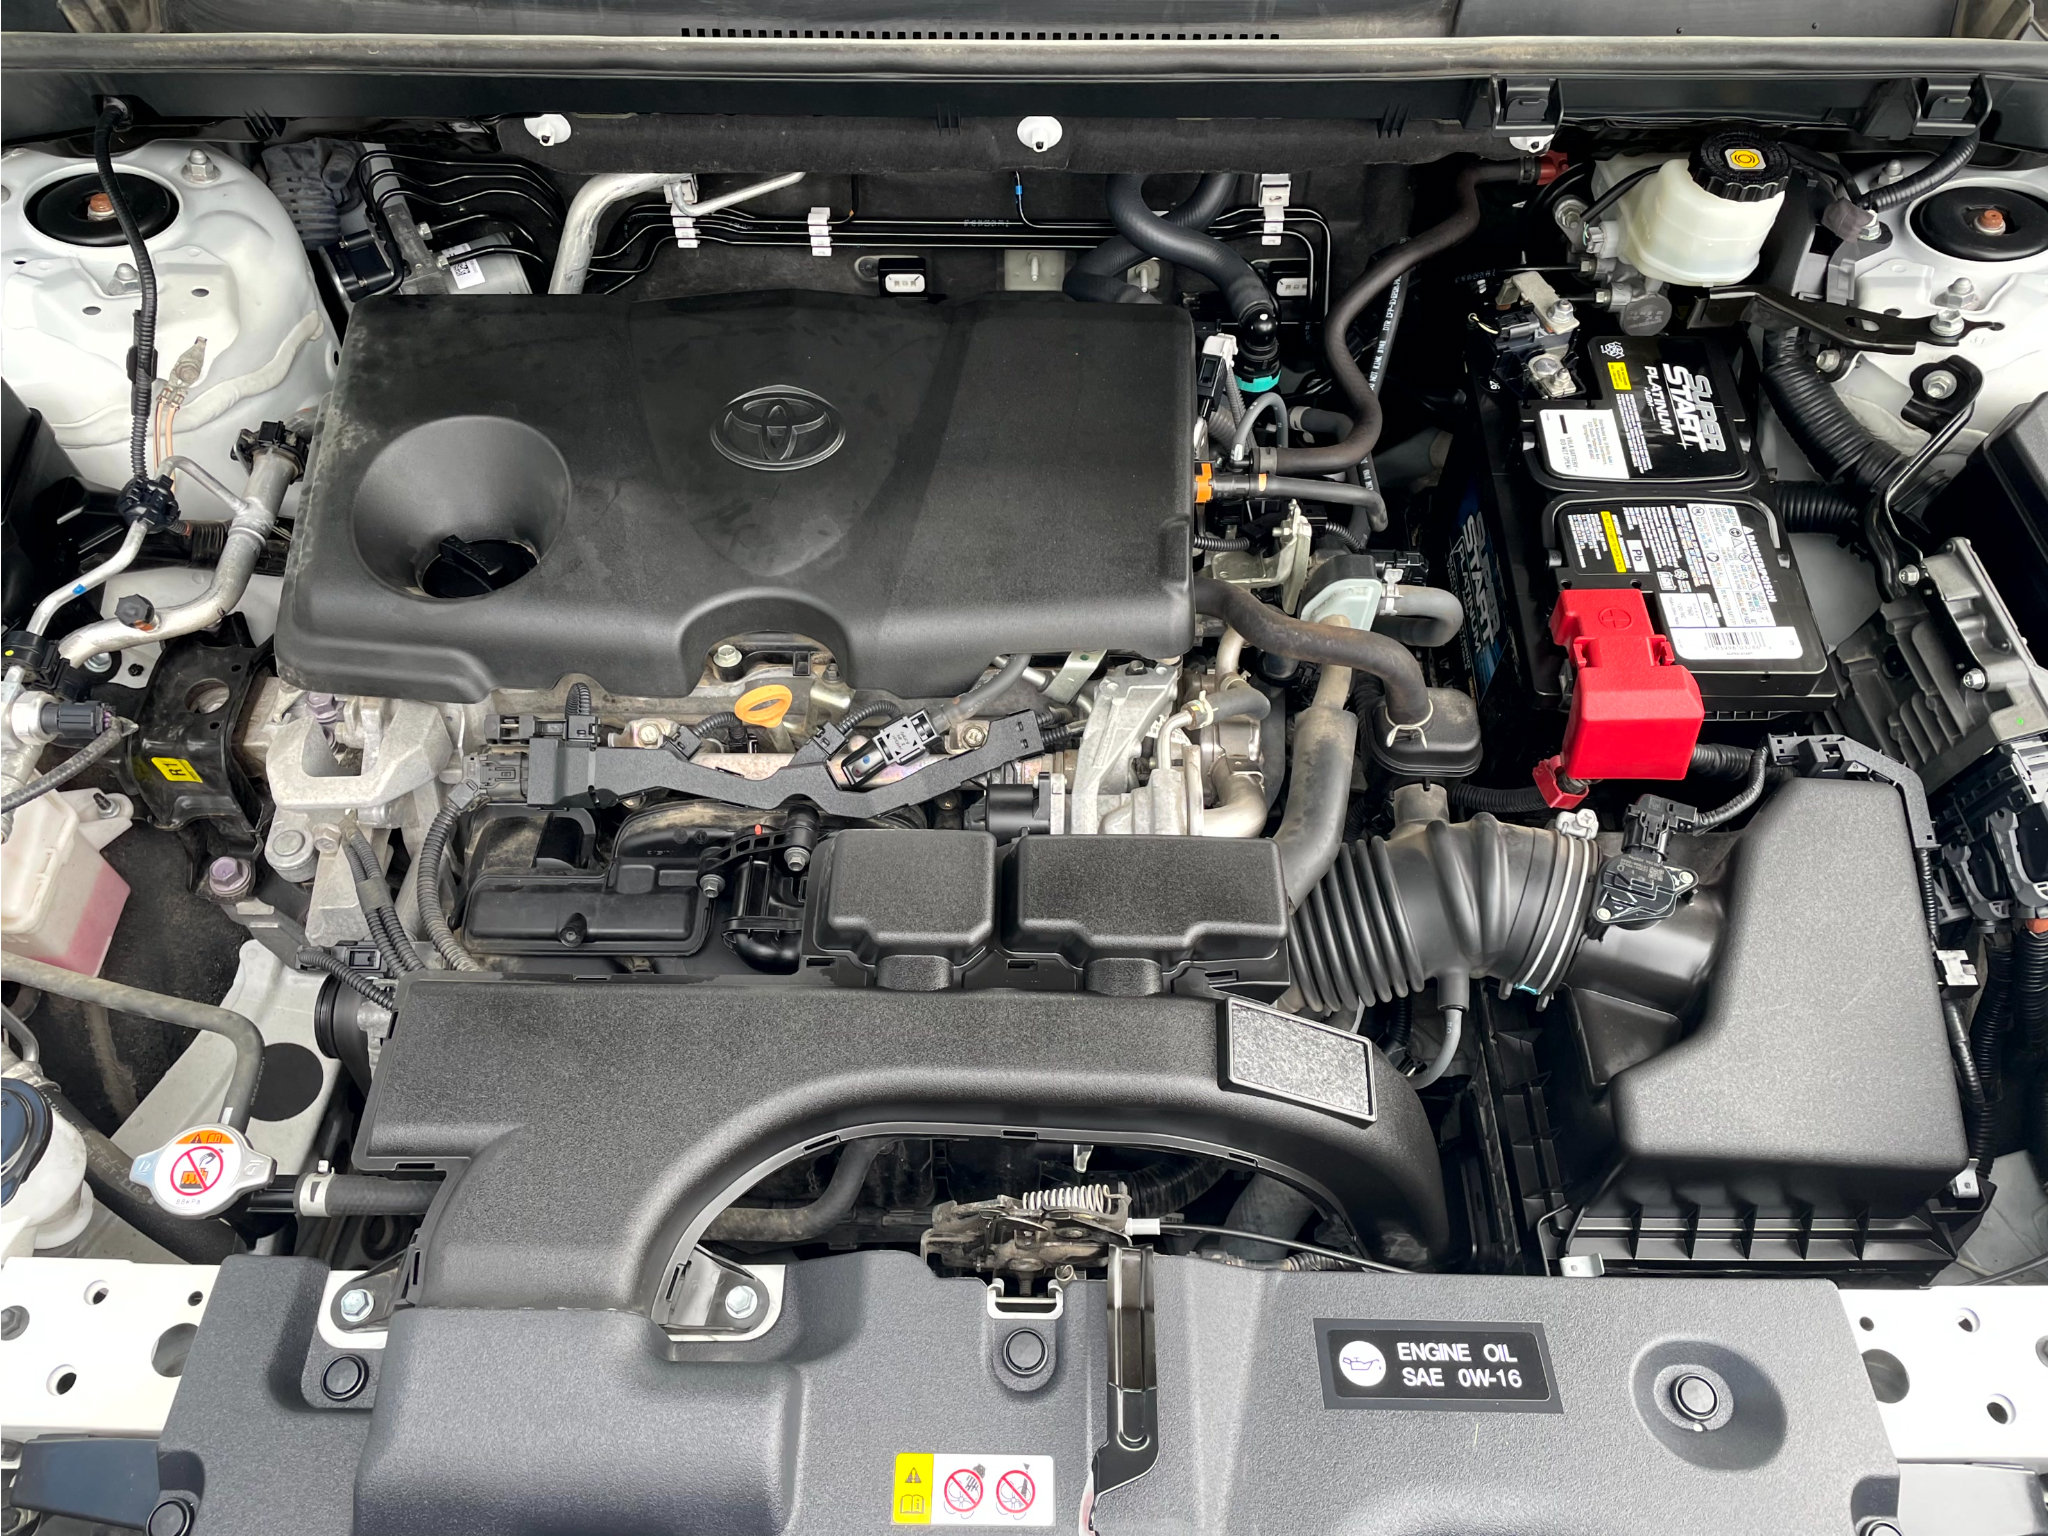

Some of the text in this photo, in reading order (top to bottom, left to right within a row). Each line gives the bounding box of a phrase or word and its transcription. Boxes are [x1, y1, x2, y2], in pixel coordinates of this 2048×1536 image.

[1644, 366, 1675, 435] PLATINUM
[1662, 363, 1707, 452] START
[1685, 374, 1726, 452] SUPER
[1463, 515, 1494, 645] START
[1475, 511, 1501, 634] SUPER
[1632, 549, 1643, 562] Pb
[1746, 534, 1778, 603] DANGER/POISON
[1457, 543, 1482, 653] PLATINUM
[1396, 1342, 1518, 1363] ENGINE OIL
[1402, 1367, 1523, 1388] SAE 0W-16
